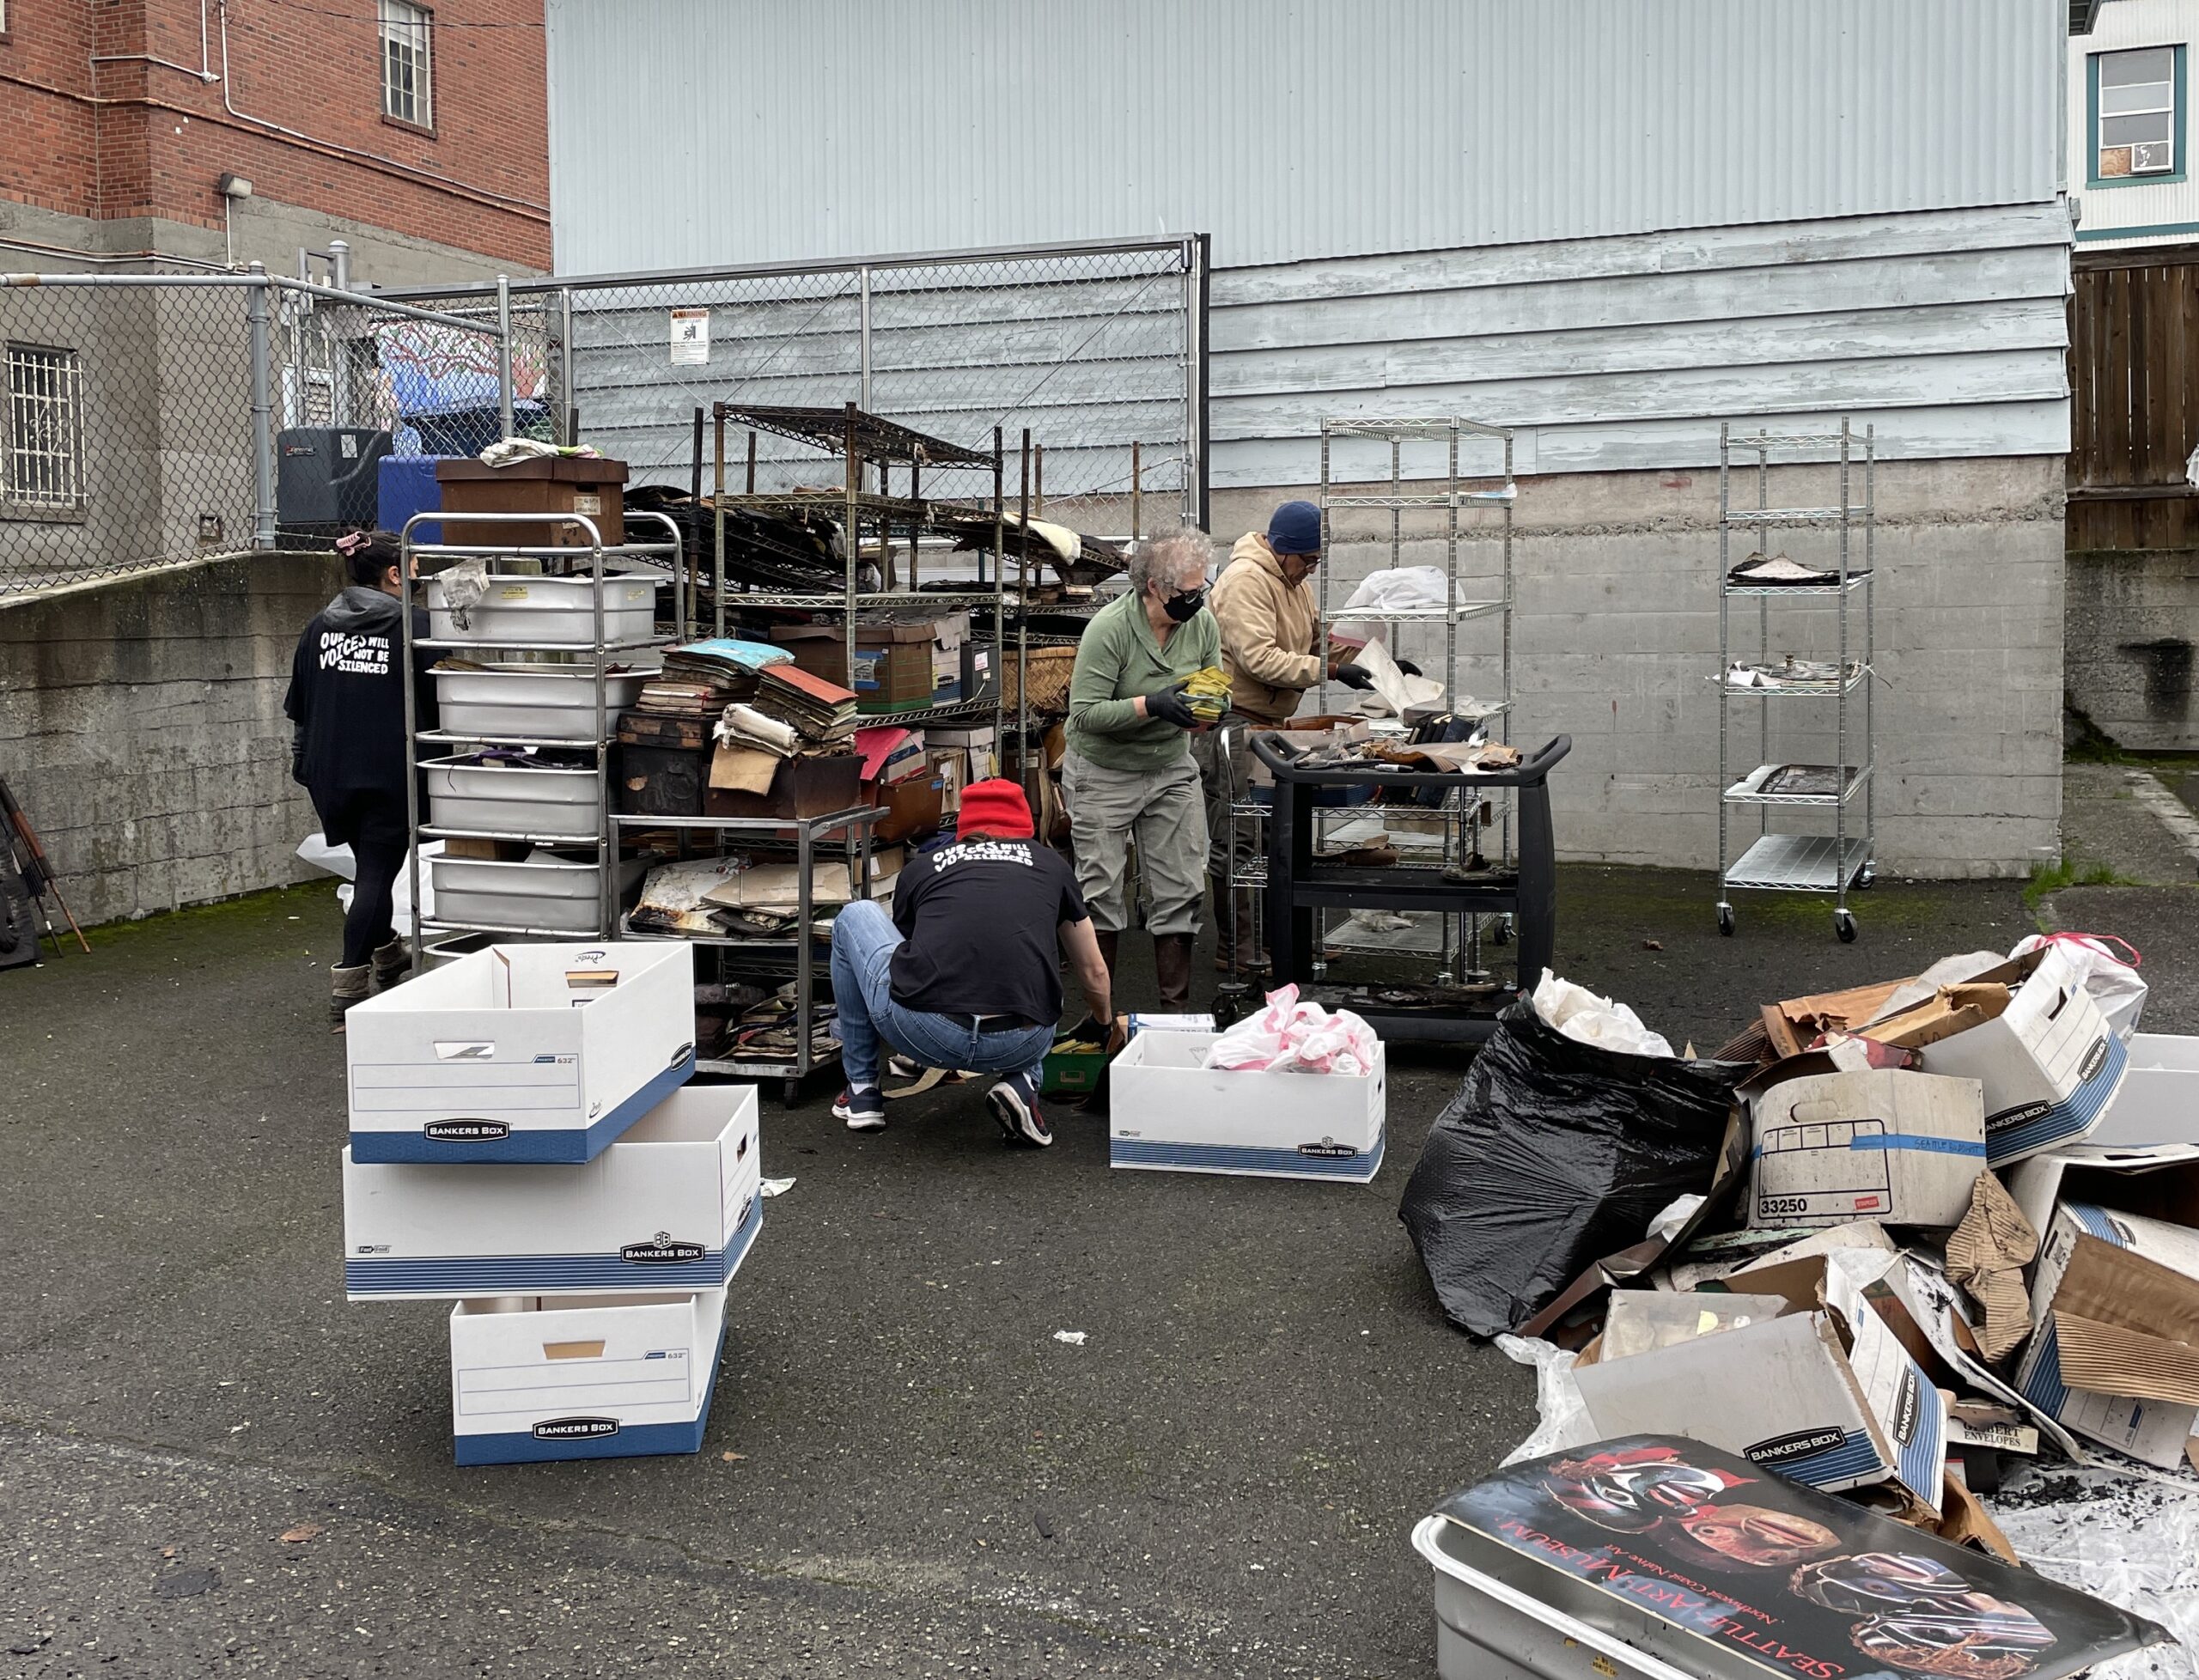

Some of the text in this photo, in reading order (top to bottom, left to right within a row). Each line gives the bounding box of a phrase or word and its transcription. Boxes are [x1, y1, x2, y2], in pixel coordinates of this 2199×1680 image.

[320, 632, 346, 649] OUR
[320, 635, 389, 670] VOICES WILL
[354, 648, 389, 662] NOT BE
[338, 660, 388, 674] SILENCED
[933, 844, 966, 862] OUR
[1016, 849, 1032, 859] BE
[2081, 1050, 2101, 1080] BANKERS
[1985, 1105, 2048, 1131] ANKERS BOX
[481, 1126, 503, 1135] BOX
[1761, 1199, 1807, 1214] 33250
[1897, 1372, 1916, 1440] BANKERS BOX
[538, 1423, 613, 1434] BANKERS BOX
[1751, 1433, 1840, 1461] BANKERS BOX
[1964, 1431, 2021, 1446] ENVELOPES
[1605, 1543, 1778, 1625] Northwest Coast Native Art
[1498, 1520, 1846, 1678] SEATTLE ART MUSEUM
